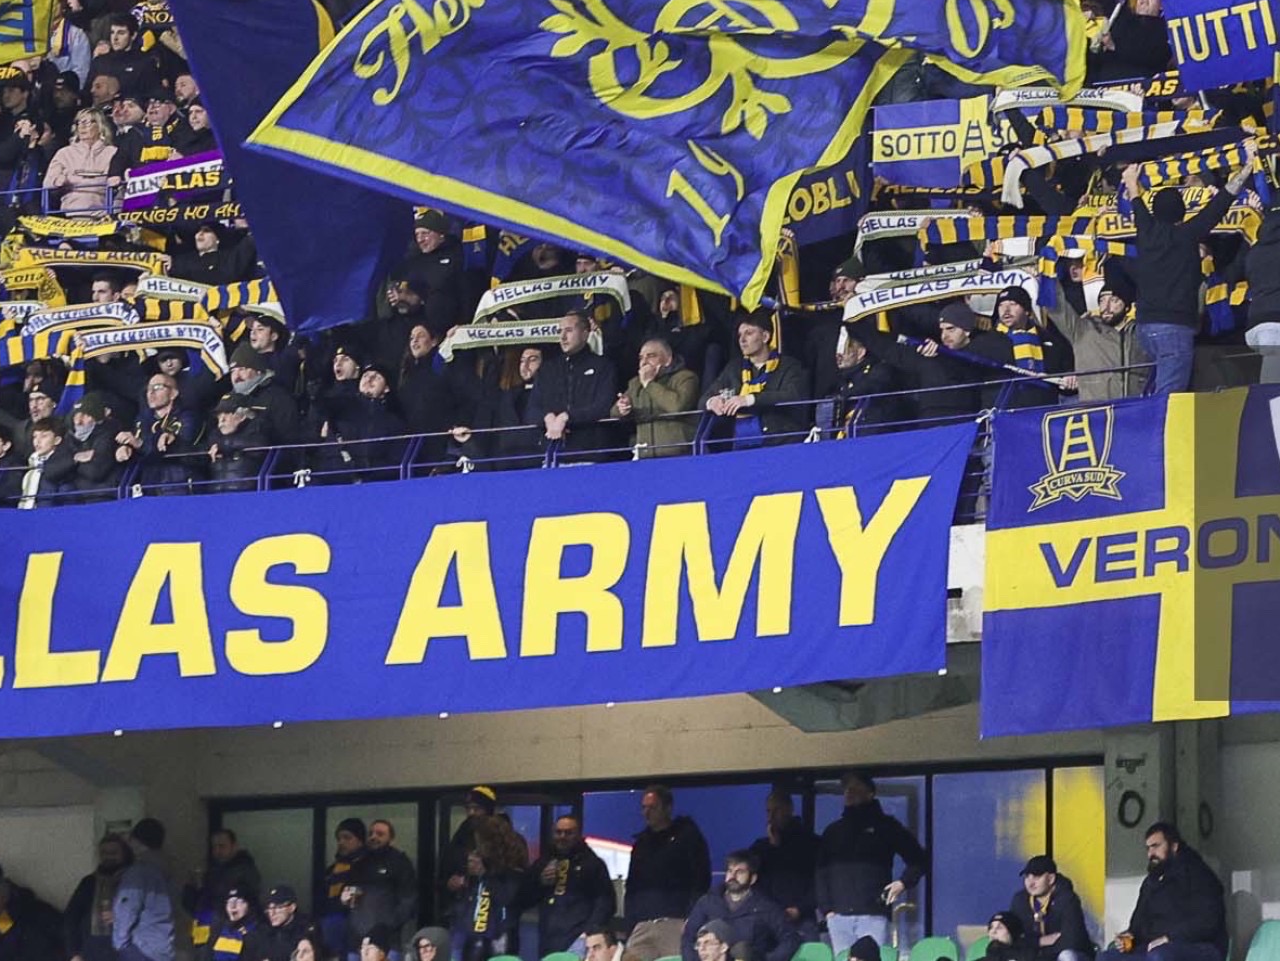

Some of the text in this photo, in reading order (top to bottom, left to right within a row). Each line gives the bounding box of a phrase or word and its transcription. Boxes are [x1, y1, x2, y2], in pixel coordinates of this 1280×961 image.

[880, 132, 960, 159] SOTTO
[493, 273, 607, 303] HELLAS ARMY
[858, 267, 1029, 309] HELLAS ARMY
[387, 475, 931, 667] ARMY
